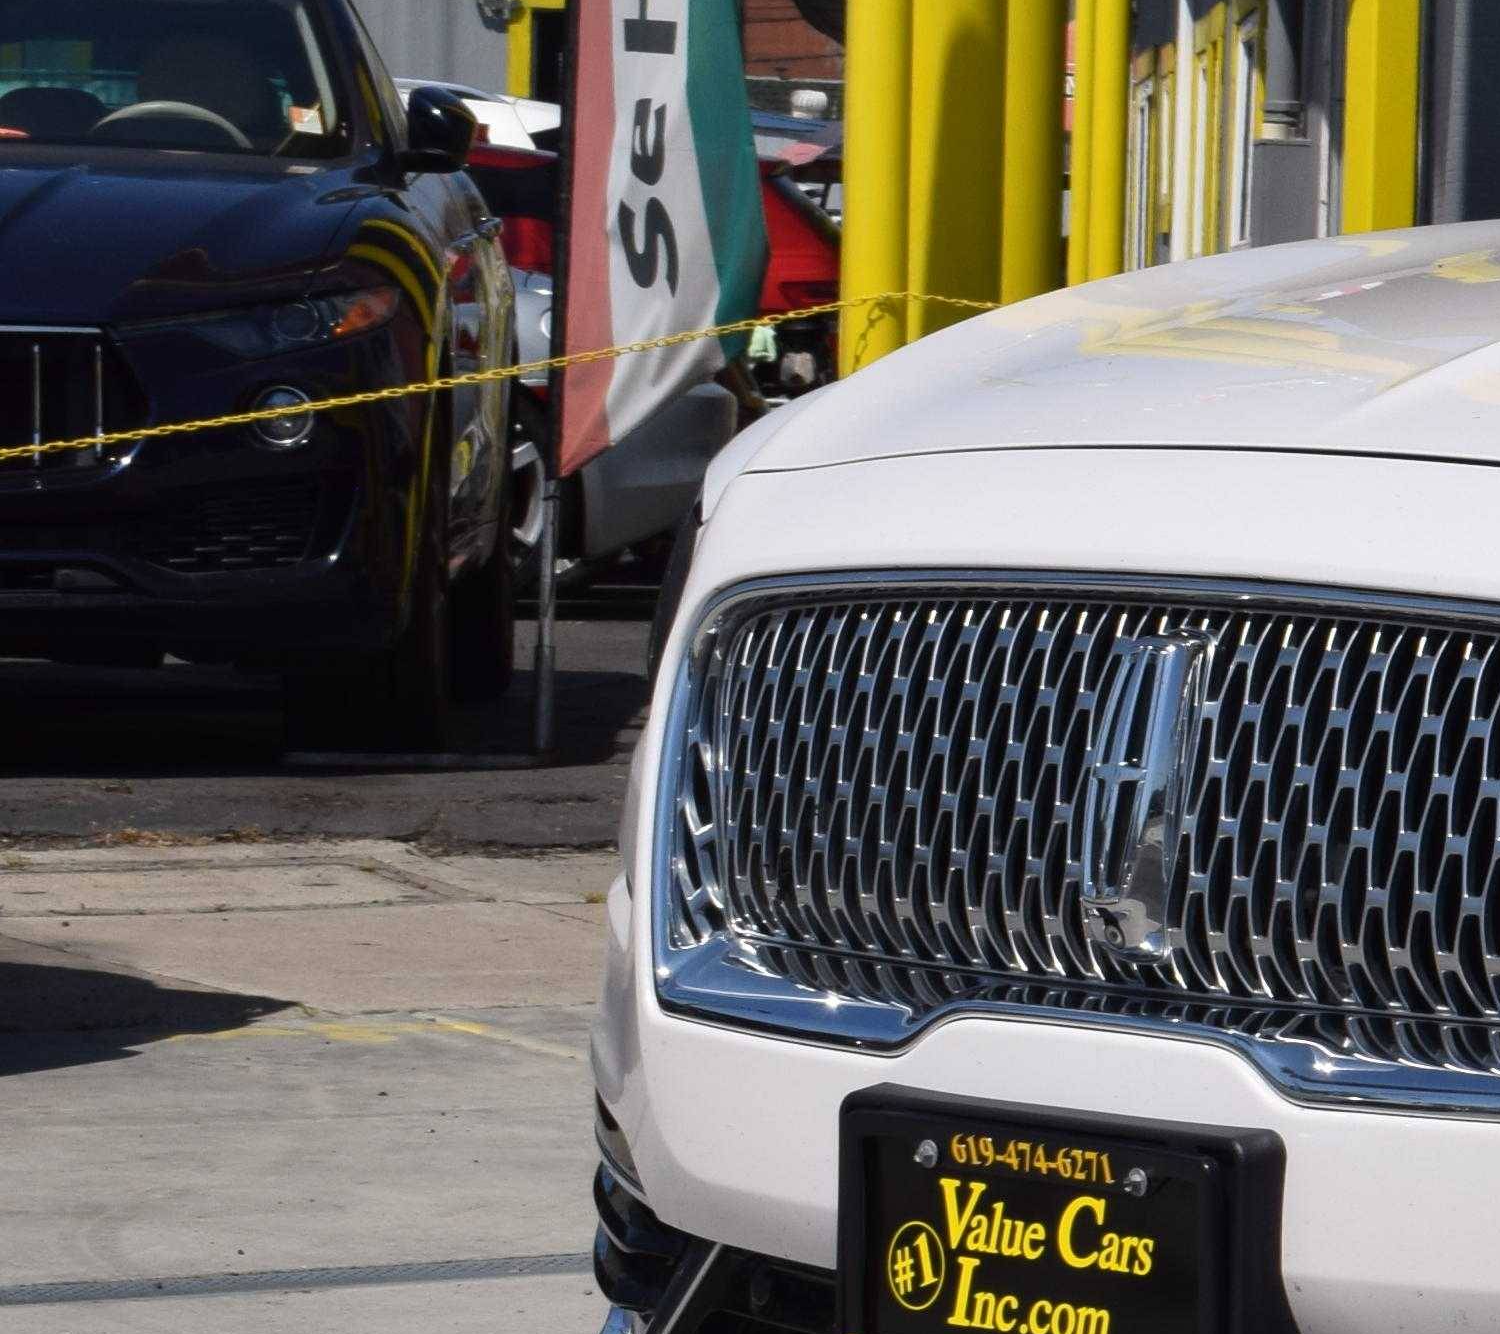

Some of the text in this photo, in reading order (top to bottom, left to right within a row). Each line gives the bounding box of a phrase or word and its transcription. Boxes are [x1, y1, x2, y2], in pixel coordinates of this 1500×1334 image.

[615, 98, 679, 299] Se
[950, 1133, 1116, 1184] 619-474-6271
[893, 1232, 940, 1296] #1
[939, 1178, 1155, 1277] Value Cars
